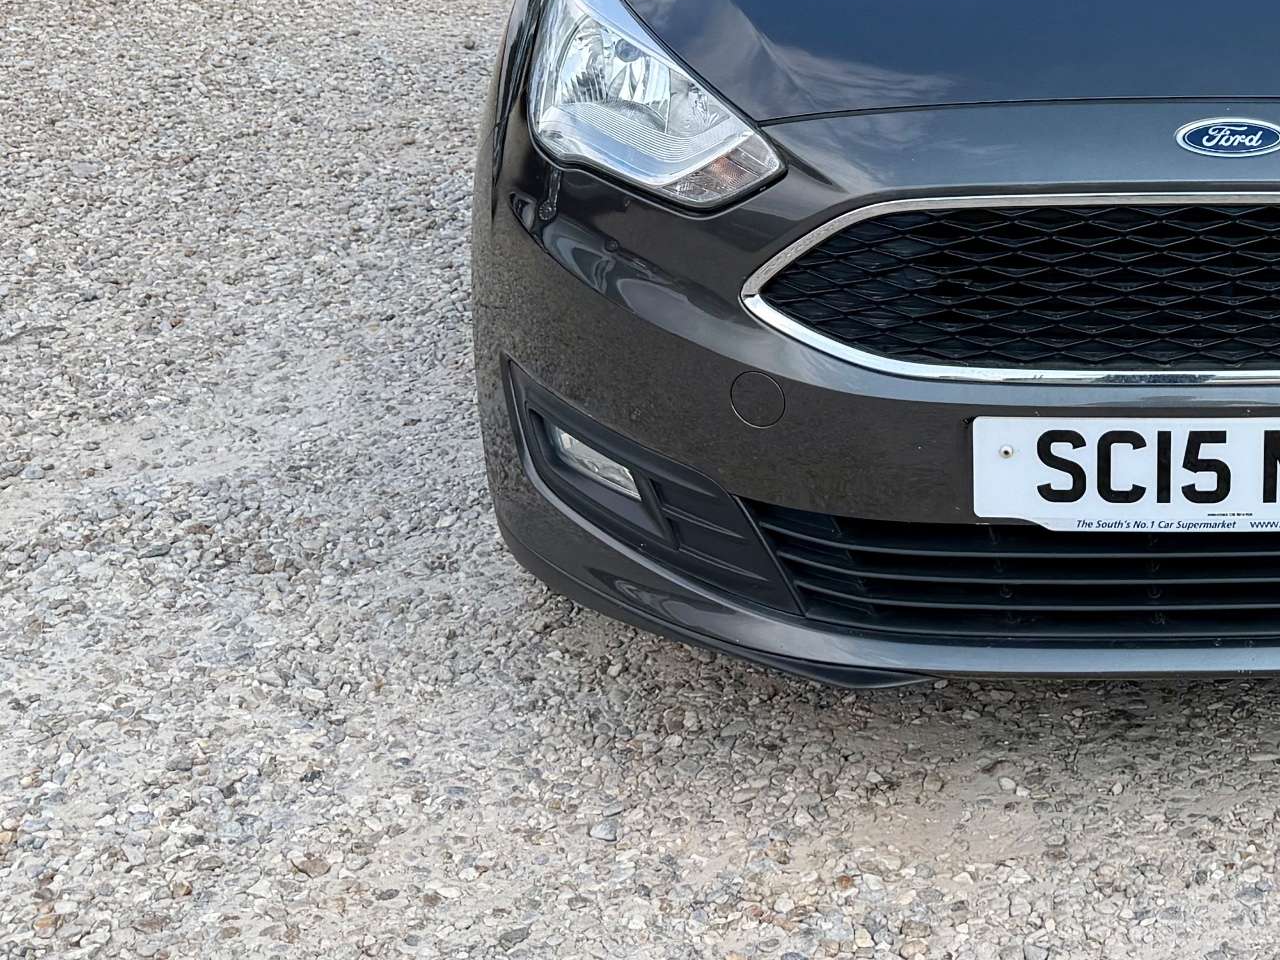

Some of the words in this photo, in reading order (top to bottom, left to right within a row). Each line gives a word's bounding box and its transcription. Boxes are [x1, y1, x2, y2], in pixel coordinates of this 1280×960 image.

[1202, 125, 1263, 147] Ford
[1036, 428, 1231, 504] SC15
[1076, 519, 1094, 529] The
[1095, 519, 1131, 529] South's
[1158, 520, 1174, 529] Car
[1175, 520, 1237, 531] Supermarket
